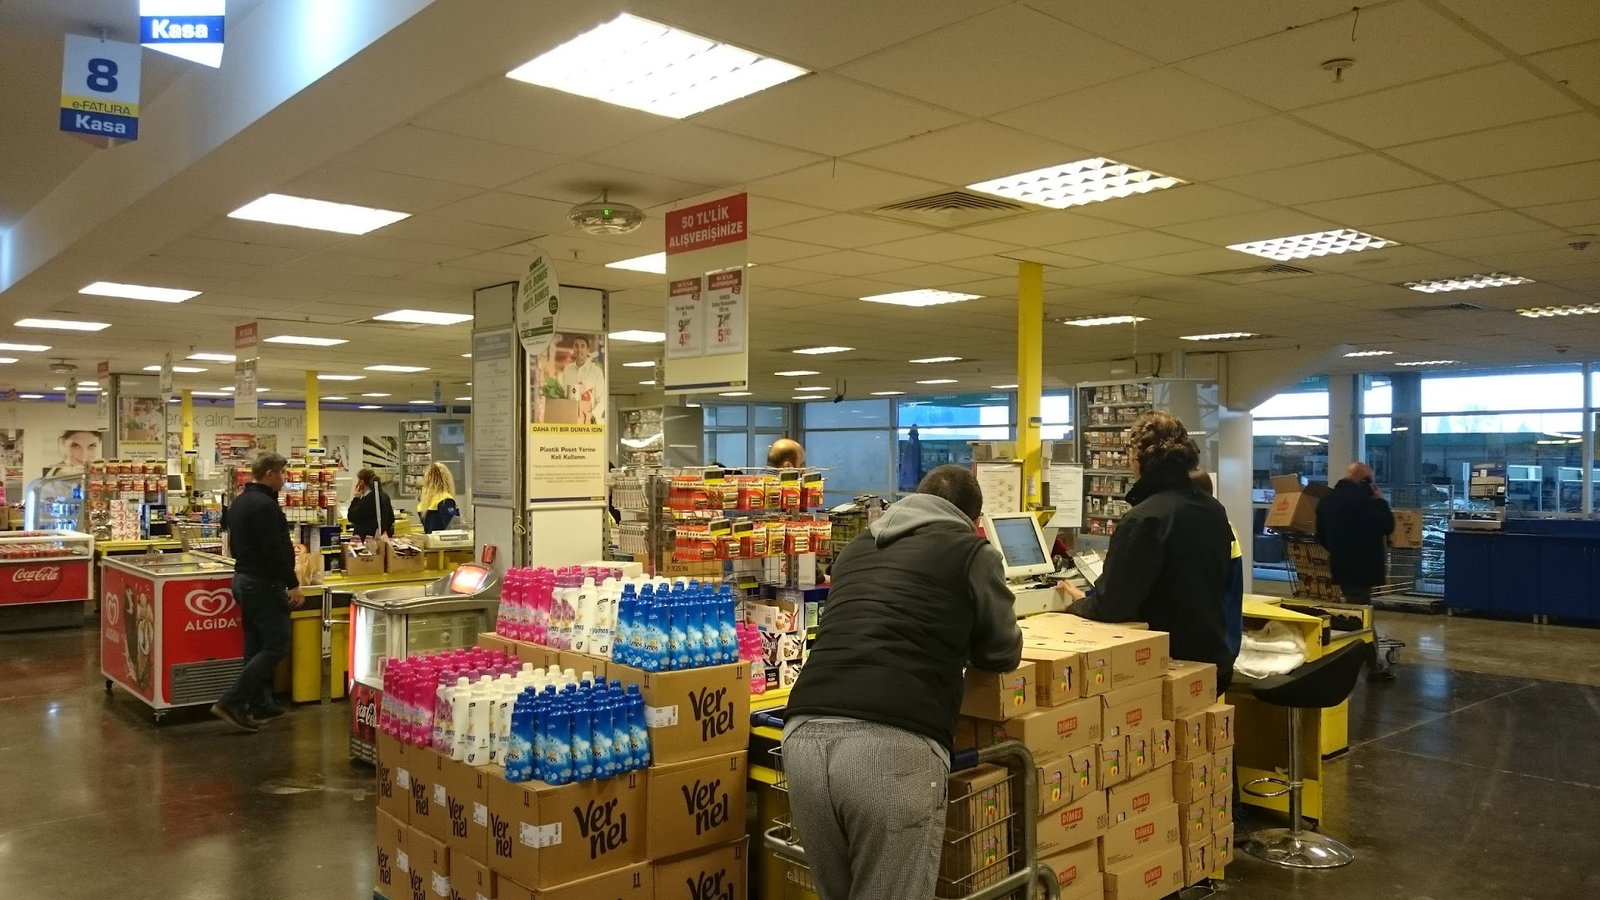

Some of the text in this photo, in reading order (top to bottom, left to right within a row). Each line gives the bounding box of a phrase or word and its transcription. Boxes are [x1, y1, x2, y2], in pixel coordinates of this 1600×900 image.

[152, 19, 208, 39] Kasa
[86, 58, 118, 93] 8
[72, 101, 131, 115] e-FATURA
[75, 114, 126, 134] Kasa
[681, 215, 694, 229] 50
[688, 686, 726, 721] Ver
[702, 702, 734, 742] nel
[411, 777, 425, 799] Ver
[681, 779, 720, 816] Ver
[415, 797, 429, 816] nel
[448, 796, 464, 820] Ver
[573, 798, 618, 838] Ver
[696, 793, 728, 835] nel
[452, 818, 467, 838] nel
[490, 812, 509, 839] Ver
[590, 813, 627, 859] nel
[377, 845, 389, 868] Ver
[495, 836, 512, 858] nel
[380, 866, 391, 885] nel
[409, 868, 423, 891] Ver
[686, 868, 726, 900] Ver
